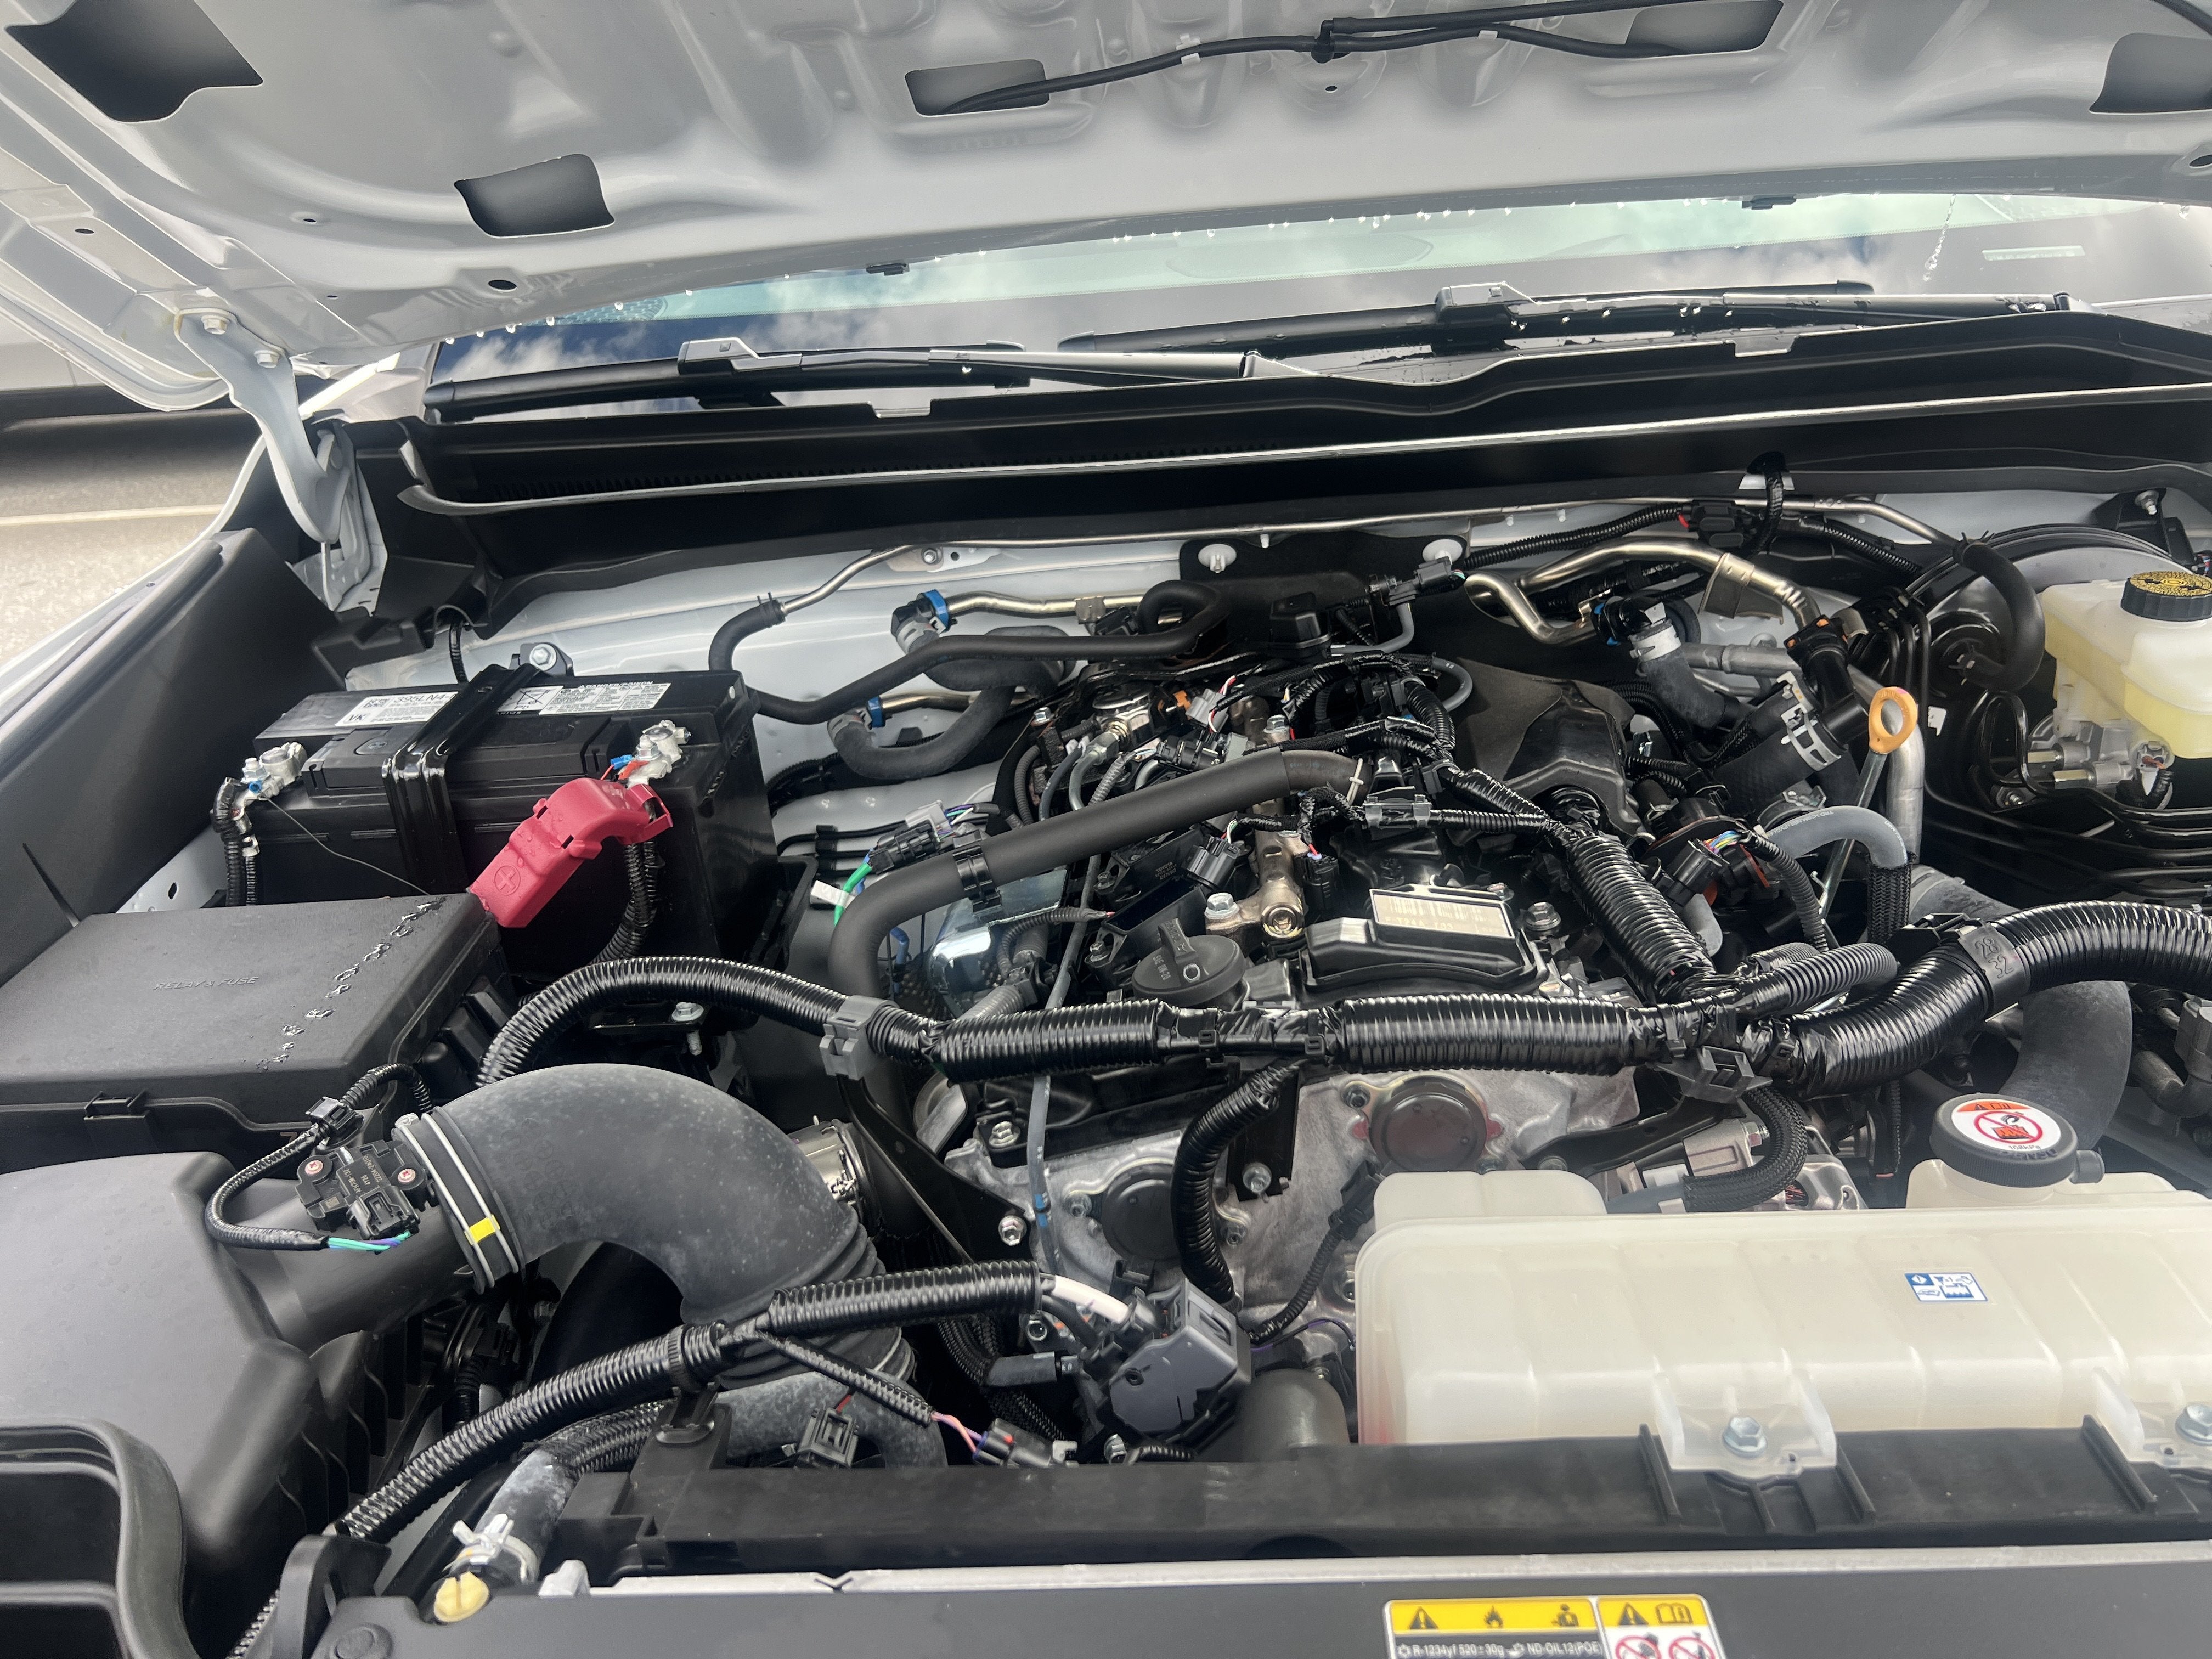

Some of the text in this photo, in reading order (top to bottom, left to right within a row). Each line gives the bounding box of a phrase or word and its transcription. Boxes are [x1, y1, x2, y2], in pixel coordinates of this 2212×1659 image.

[1974, 936, 2001, 960] 28
[1988, 954, 2015, 979] 32
[153, 980, 206, 990] RELAY
[218, 976, 259, 986] FUSE
